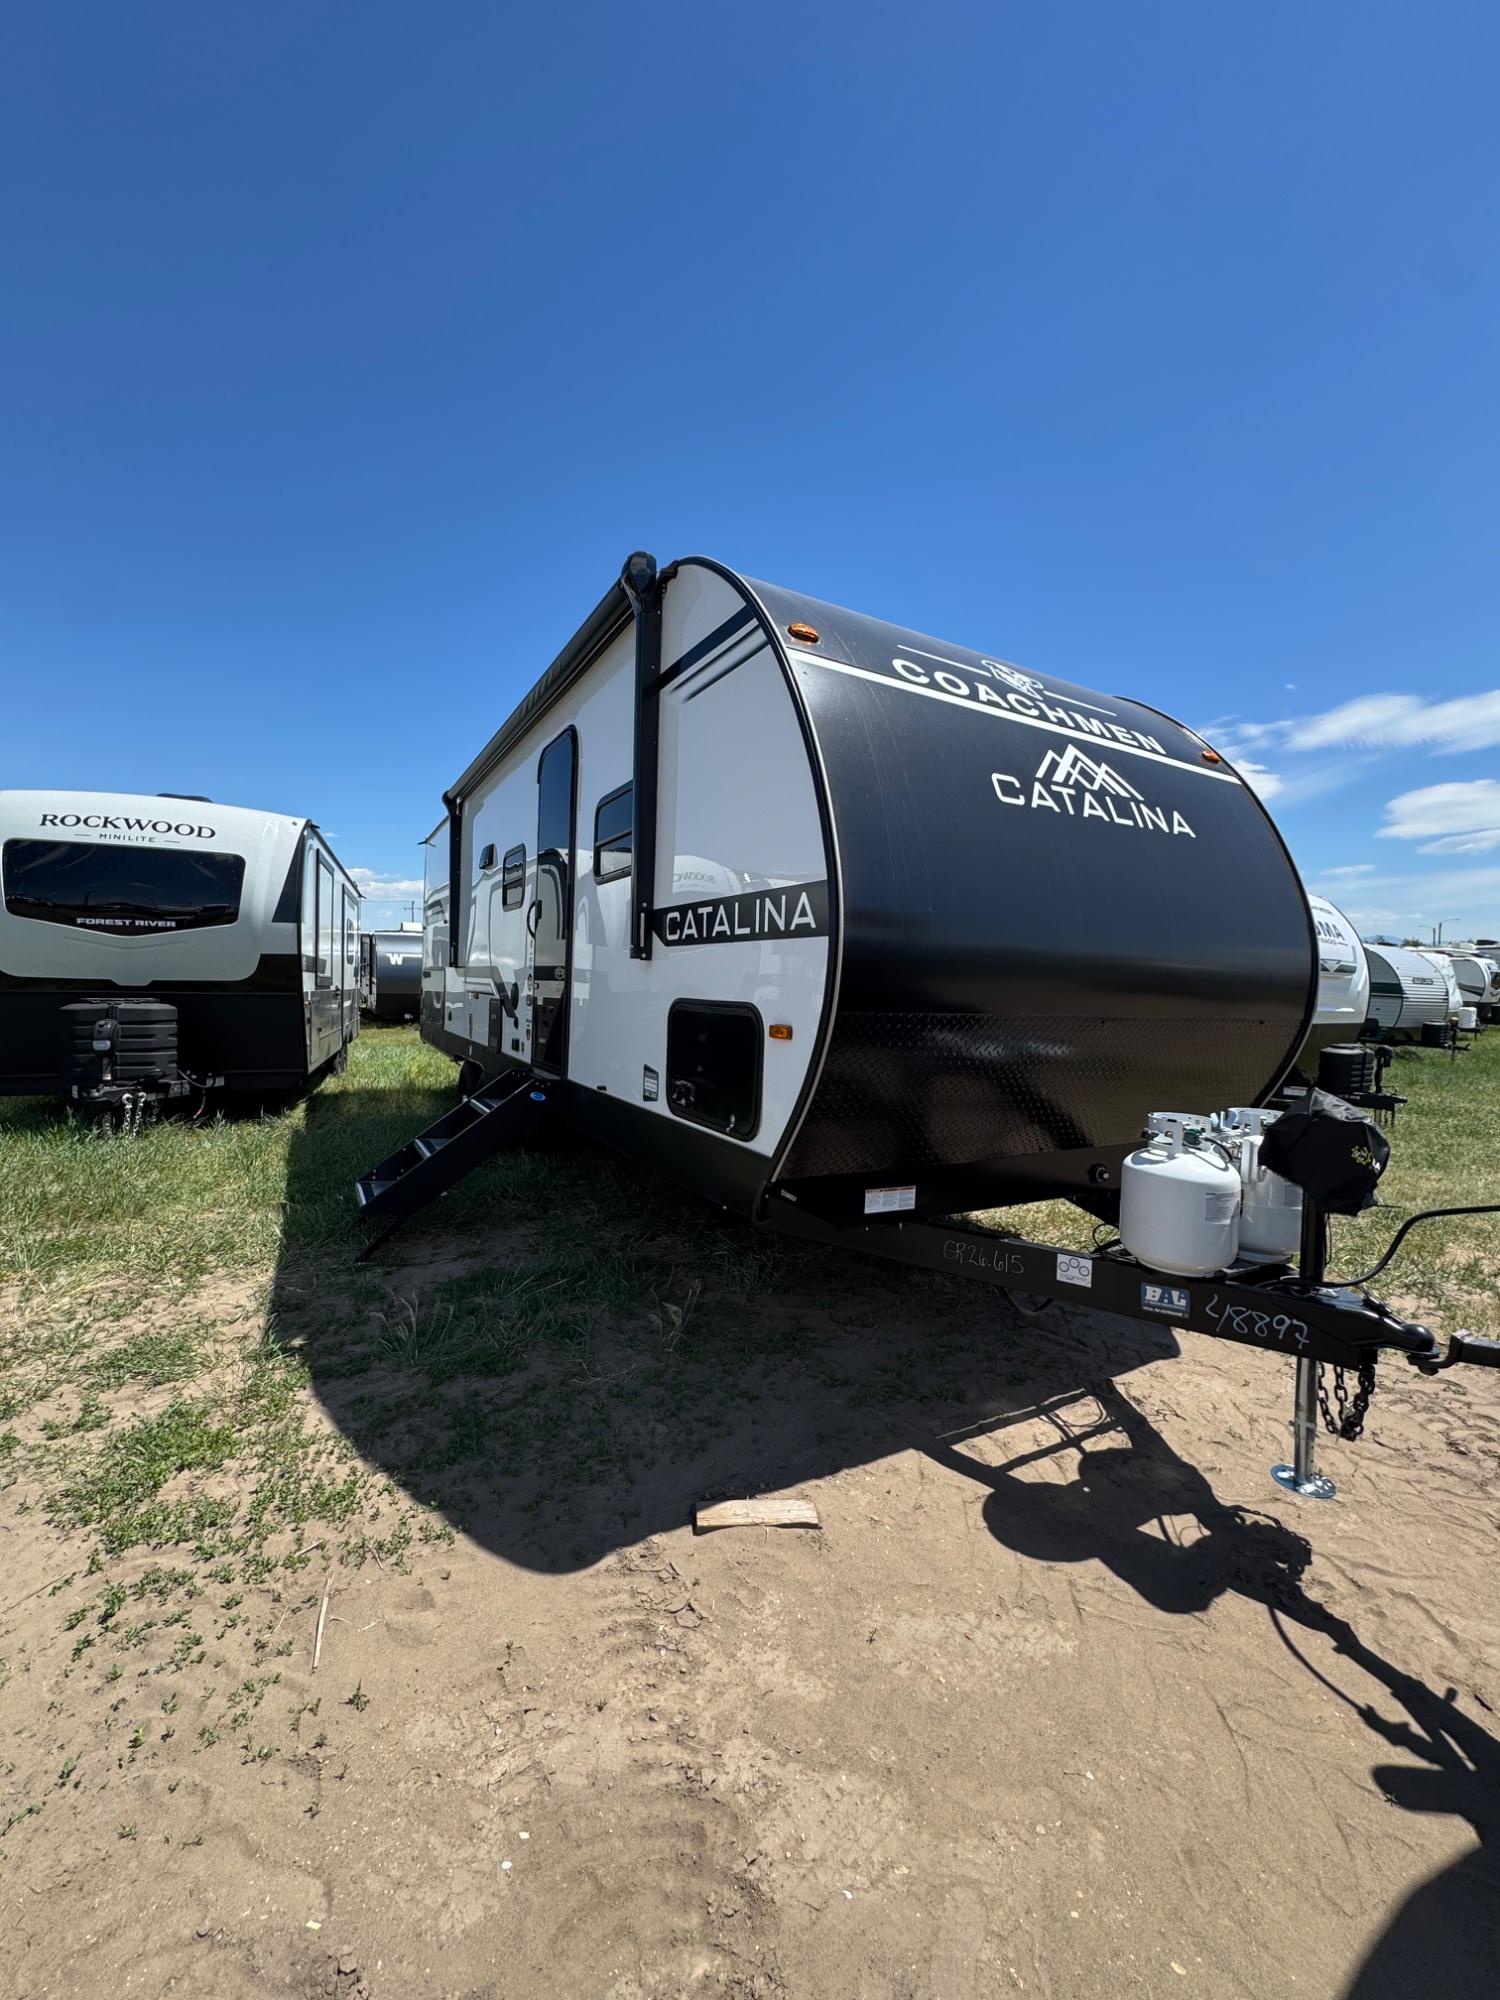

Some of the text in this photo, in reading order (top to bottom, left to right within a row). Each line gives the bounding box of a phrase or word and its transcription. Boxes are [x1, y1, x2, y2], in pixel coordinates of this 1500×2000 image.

[892, 658, 1167, 756] COACHMEN
[991, 772, 1196, 839] CATALINA
[40, 813, 216, 839] ROCKWOOD
[99, 833, 156, 842] MINILITE
[77, 917, 176, 928] FOREST RIVER
[664, 891, 817, 941] CATALINA
[1145, 1285, 1187, 1307] BAL
[1205, 1293, 1311, 1350] 48897
